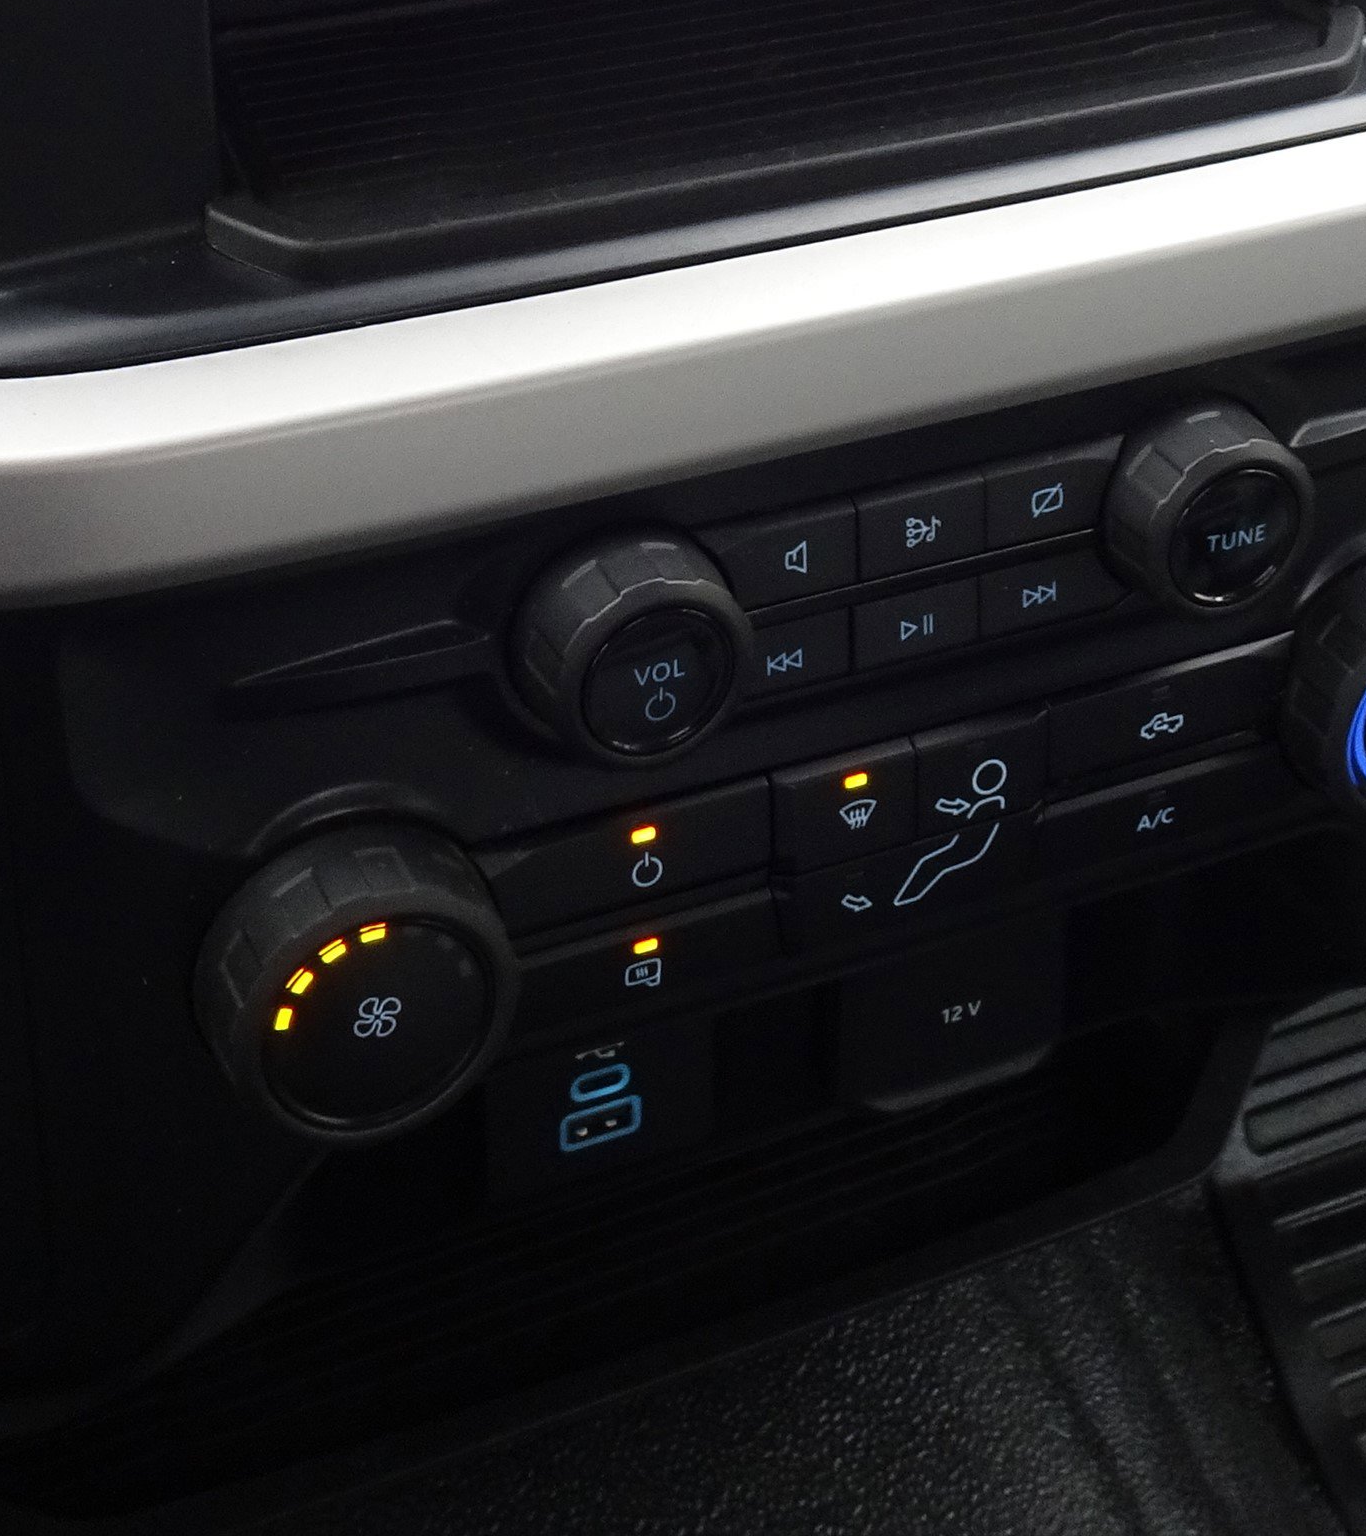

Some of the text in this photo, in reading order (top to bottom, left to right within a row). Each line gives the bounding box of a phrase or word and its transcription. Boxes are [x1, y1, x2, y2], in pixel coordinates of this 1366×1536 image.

[1207, 523, 1267, 553] TUNE
[634, 658, 686, 686] VOL
[1136, 805, 1176, 833] A/C
[941, 1000, 982, 1024] 12 V
